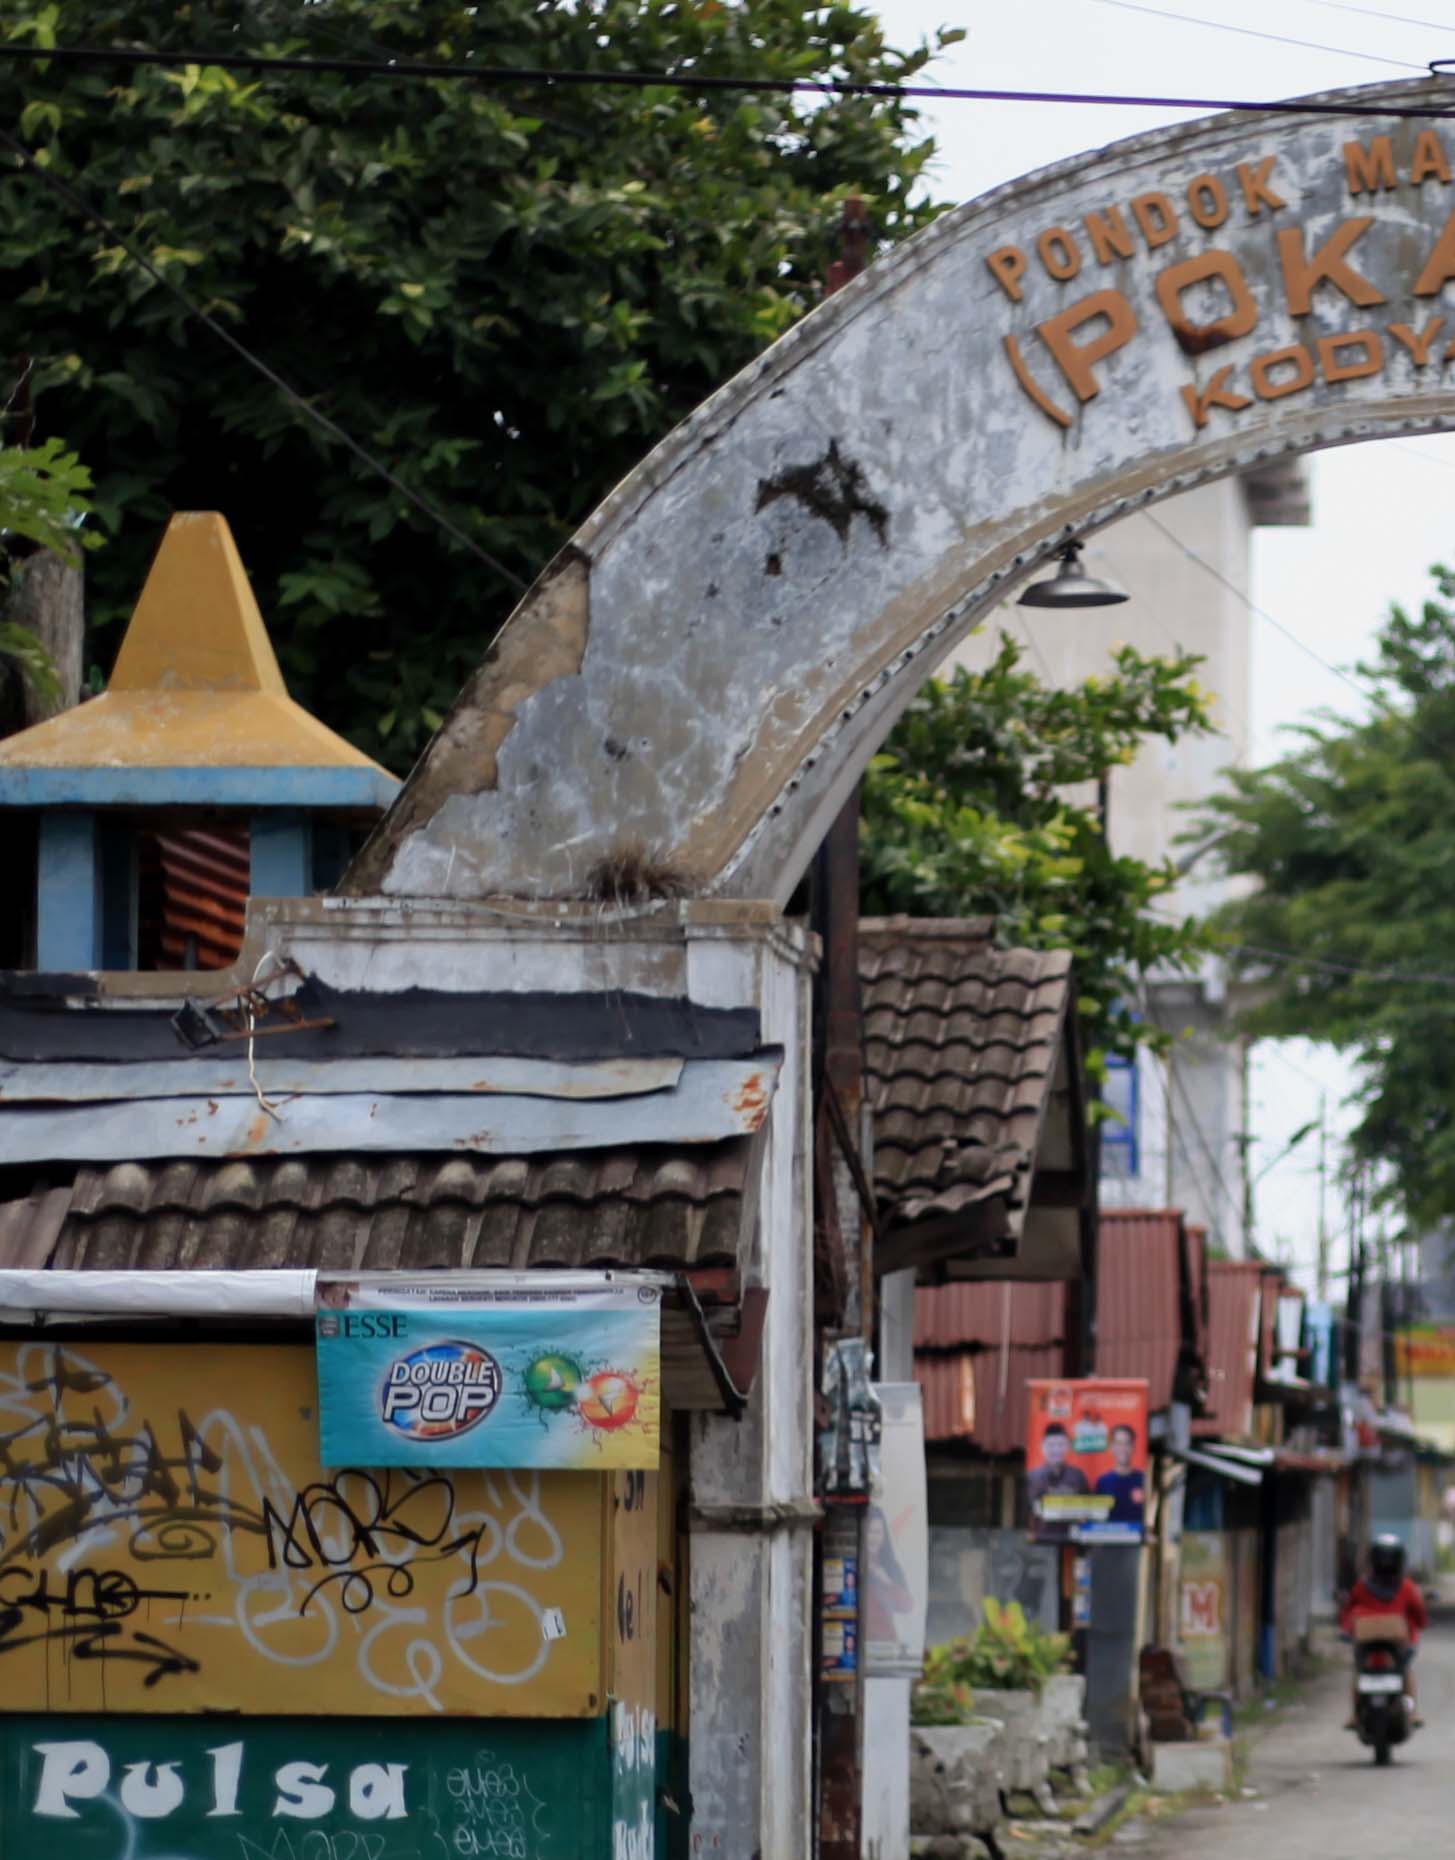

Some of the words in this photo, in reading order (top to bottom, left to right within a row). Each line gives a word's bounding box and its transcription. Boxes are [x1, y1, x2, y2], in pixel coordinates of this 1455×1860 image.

[986, 154, 1287, 300] PONDOK
[344, 1315, 408, 1338] ESSE
[390, 1360, 495, 1386] DOUBLE
[382, 1383, 495, 1423] POP
[32, 1740, 410, 1819] Pulsa
